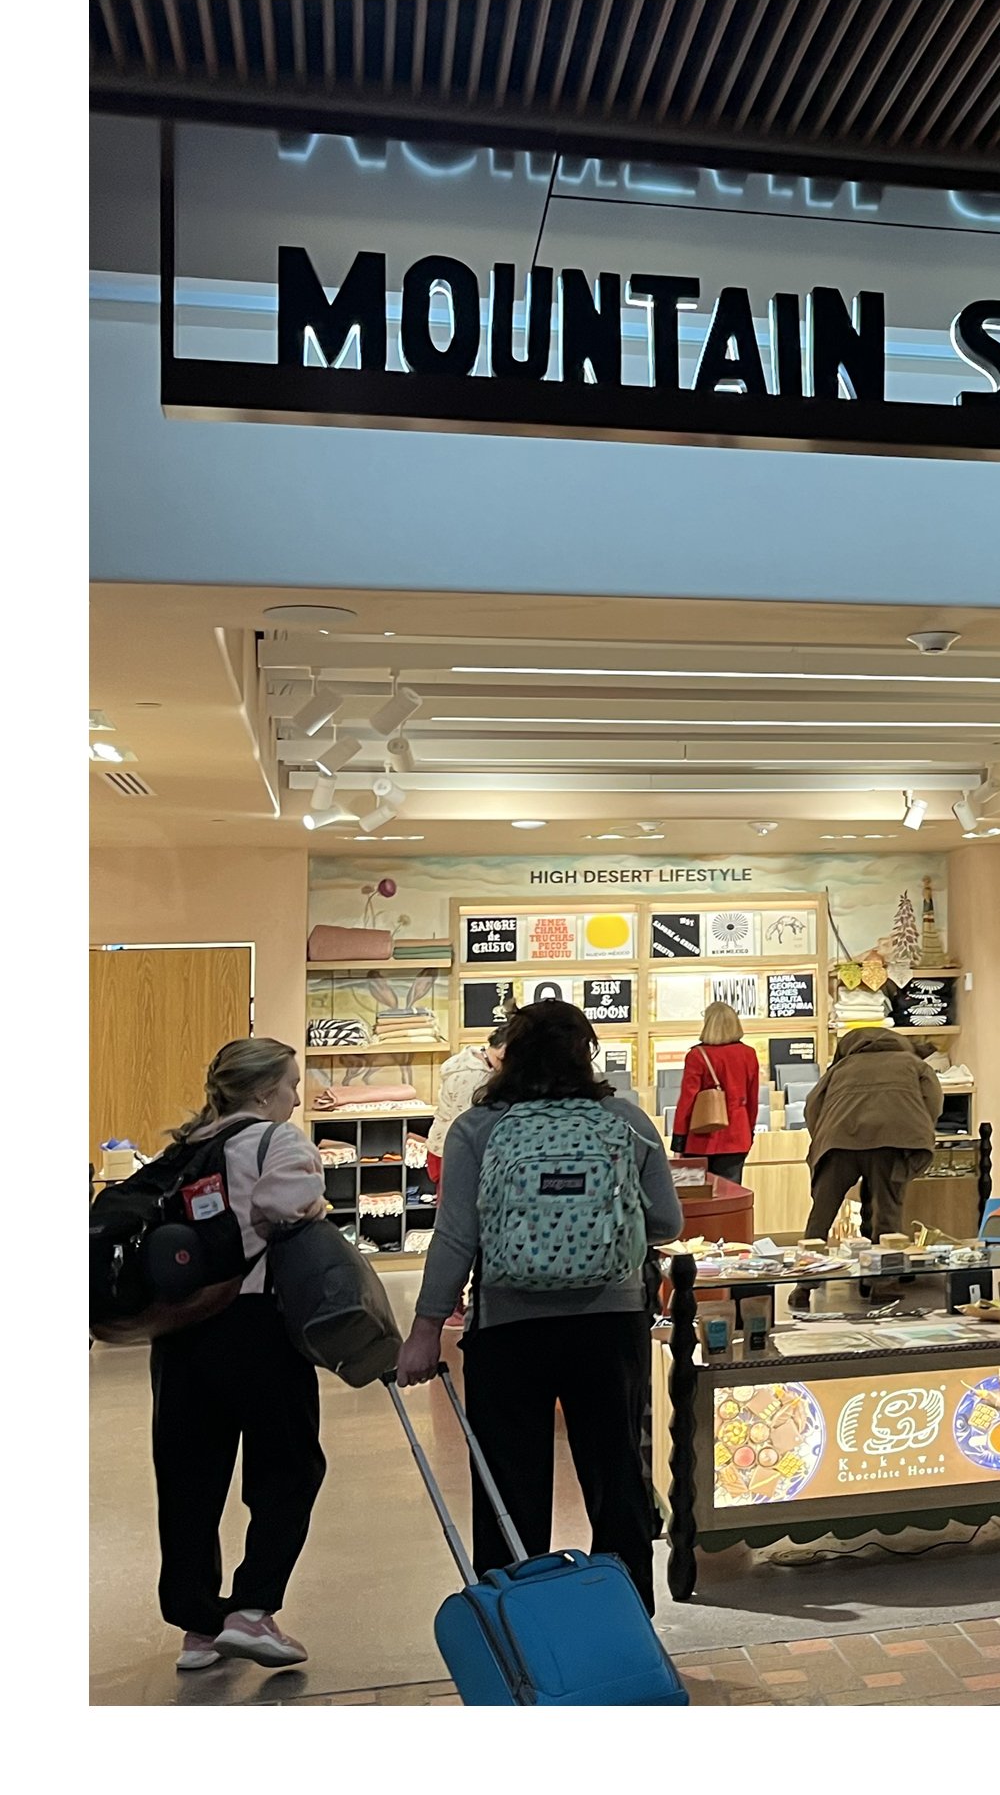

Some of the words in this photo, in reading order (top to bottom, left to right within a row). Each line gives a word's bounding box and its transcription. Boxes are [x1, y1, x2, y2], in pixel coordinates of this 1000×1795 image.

[277, 245, 886, 406] MOUNTAIN
[530, 870, 577, 884] HIGH
[584, 869, 653, 884] DESERT
[659, 868, 752, 882] LIFESTYLE
[469, 919, 517, 932] SANGRE
[535, 918, 567, 927] JEMEZ
[534, 926, 568, 934] CHAMA
[487, 931, 501, 941] de
[529, 934, 574, 942] TRUCHAS
[472, 941, 515, 954] CRISTO
[538, 942, 568, 950] PECOS
[769, 975, 796, 983] MARIA
[591, 980, 621, 995] SUN
[769, 982, 807, 990] GEORGIA
[769, 989, 798, 997] AGNES
[600, 994, 613, 1006] &
[769, 1002, 813, 1011] GERONIMA
[583, 1005, 629, 1020] MOON
[777, 1009, 796, 1017] POP
[837, 1469, 900, 1482] Chocolate
[907, 1465, 945, 1476] House
